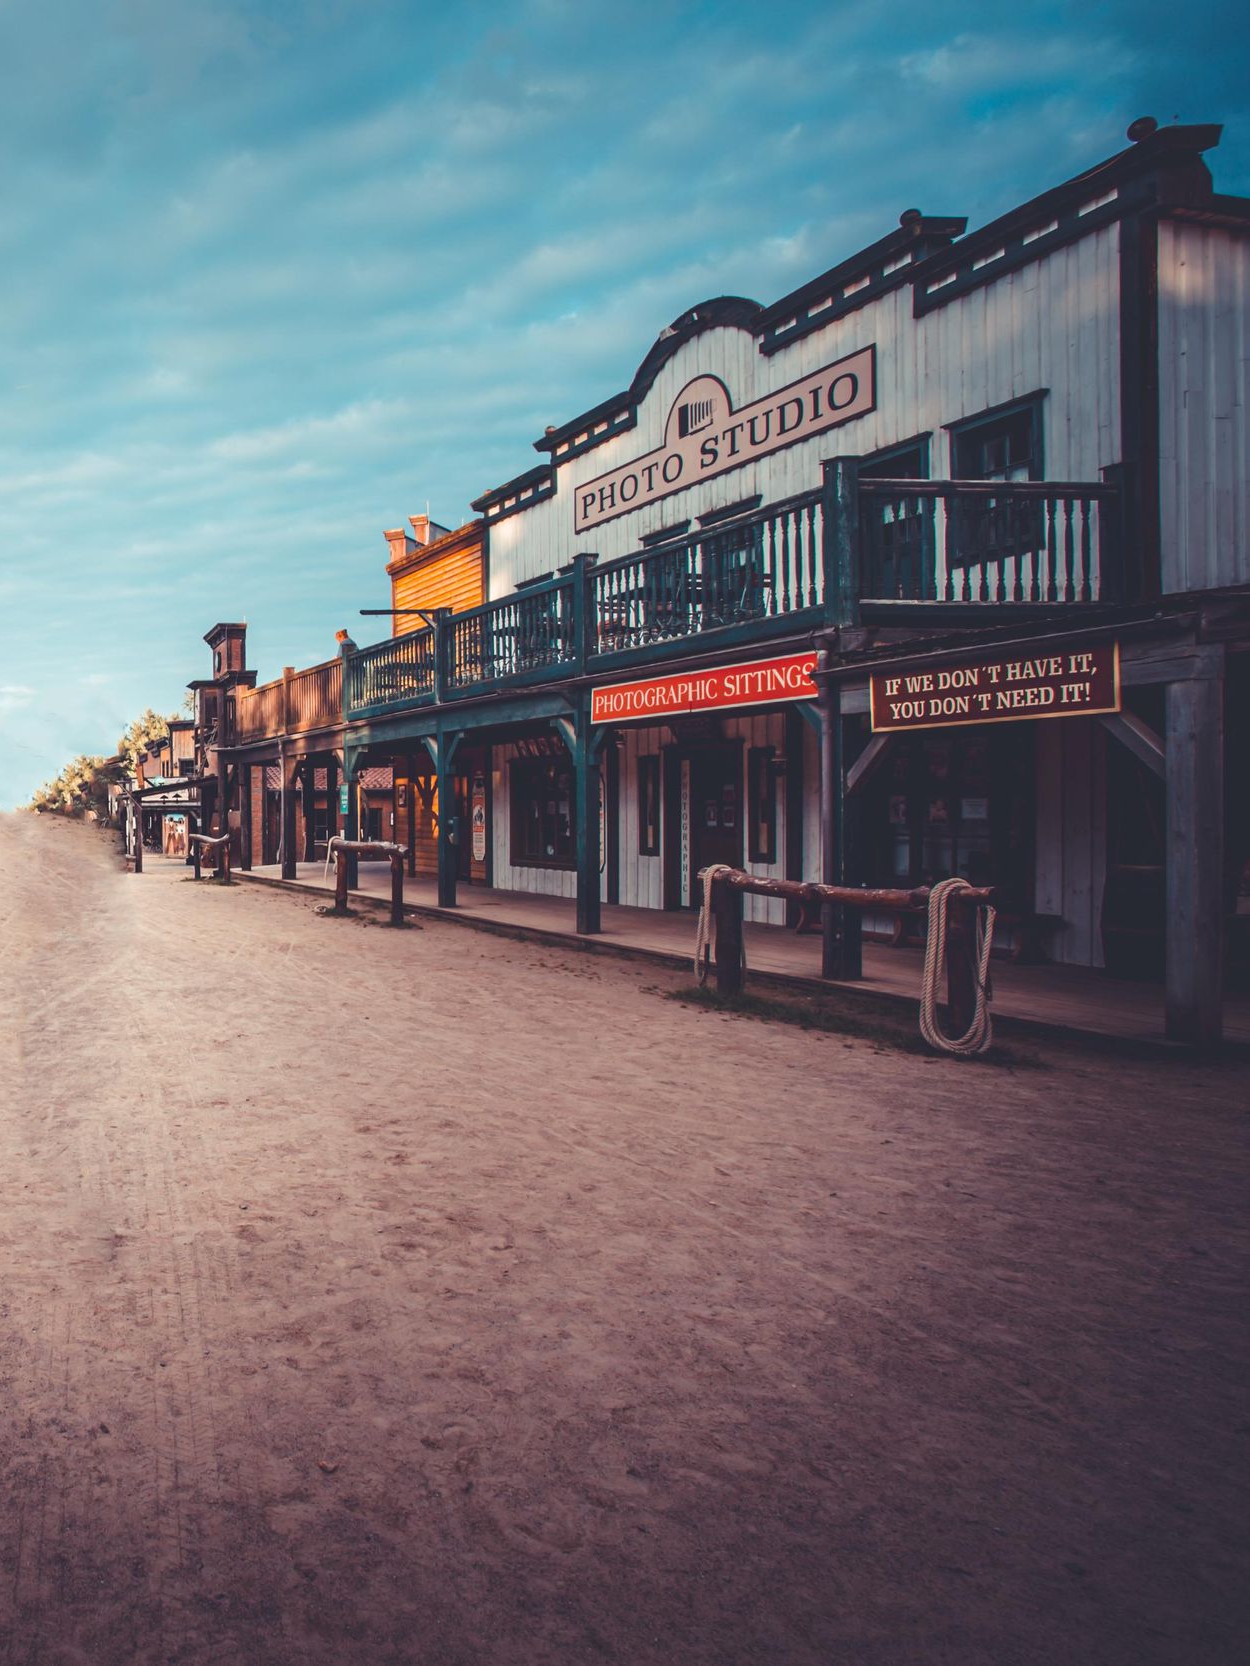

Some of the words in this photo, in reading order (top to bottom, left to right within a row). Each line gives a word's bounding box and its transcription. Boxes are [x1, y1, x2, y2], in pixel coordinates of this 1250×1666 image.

[581, 453, 684, 521] PHOTO
[700, 372, 860, 470] STUDIO
[595, 678, 718, 714] PHOTOGRAPHIC
[723, 662, 815, 697] SITTINGS
[885, 679, 901, 696] IF
[905, 675, 934, 694] WE
[1006, 656, 1063, 681] HAVE
[1068, 653, 1097, 676] IT,
[889, 700, 925, 720] YOU
[996, 686, 1055, 710] NEED
[1060, 682, 1091, 704] IT!
[681, 770, 689, 892] PHOTOGRAPHIC
